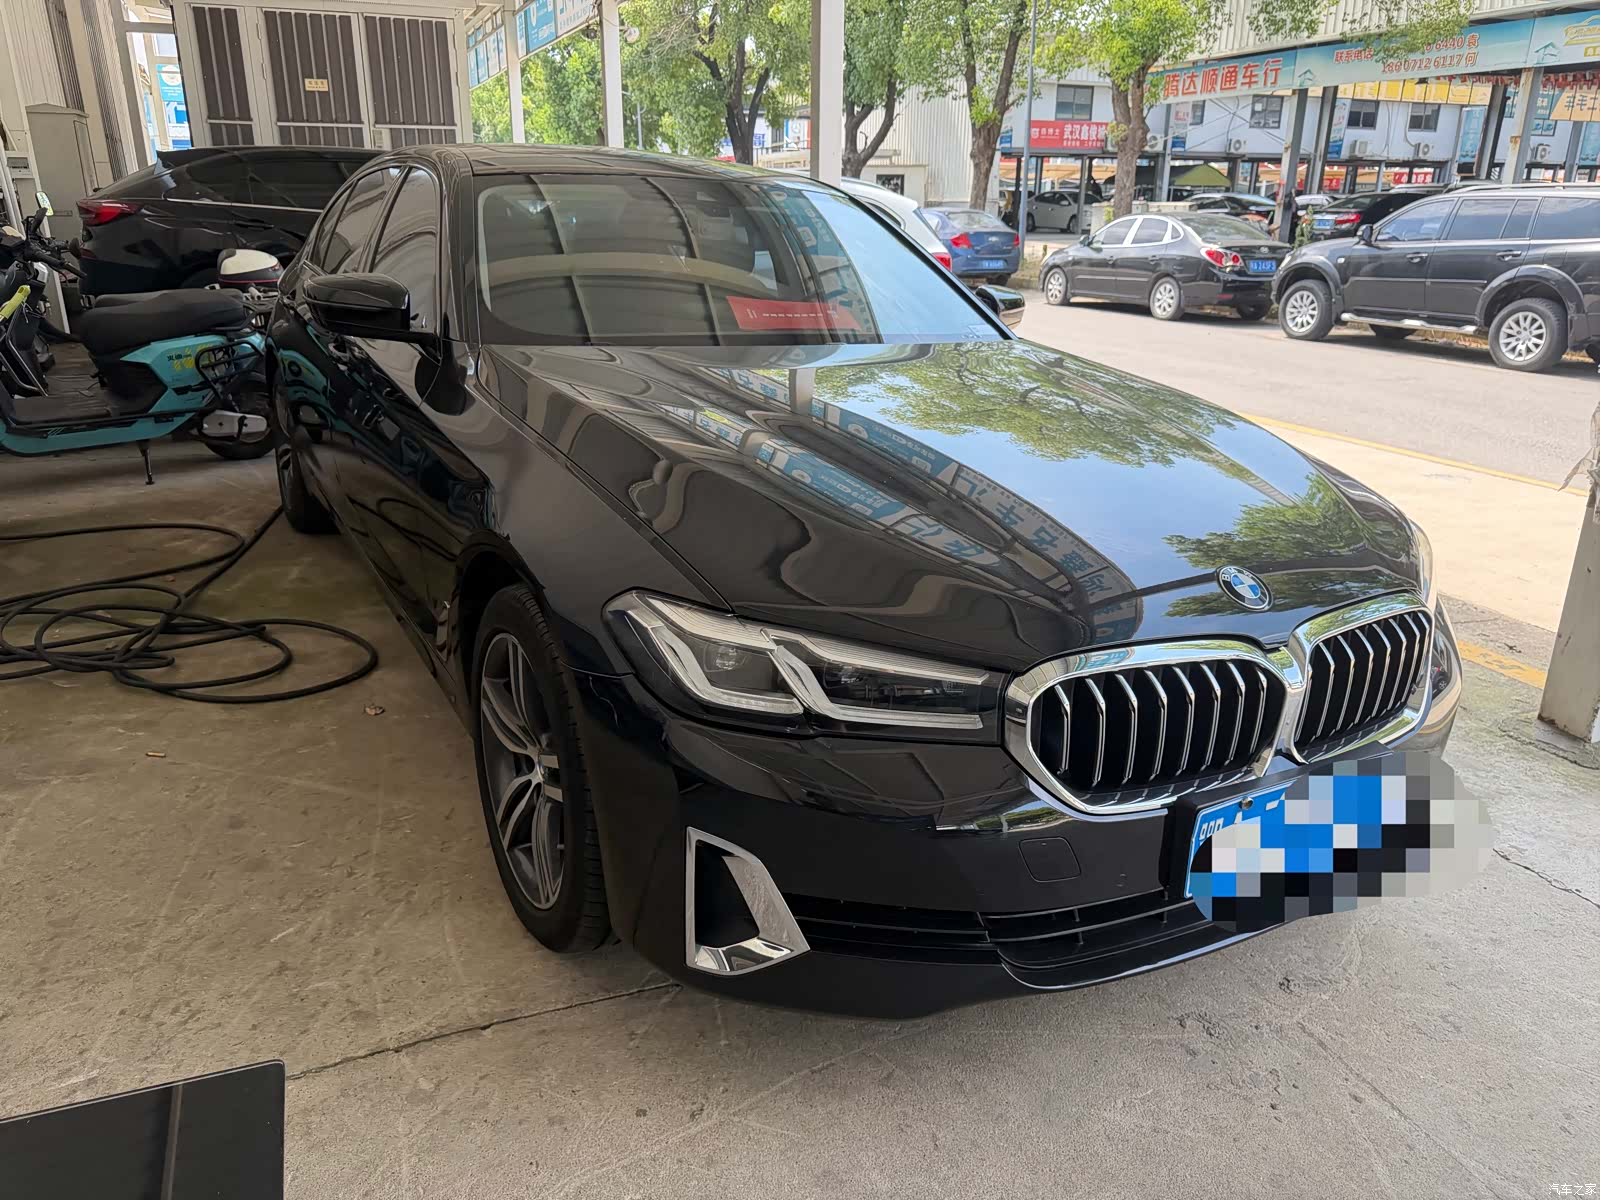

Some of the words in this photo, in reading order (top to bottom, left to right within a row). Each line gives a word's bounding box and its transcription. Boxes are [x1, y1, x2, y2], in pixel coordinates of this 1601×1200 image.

[1163, 57, 1283, 98] 腾达顺通车行
